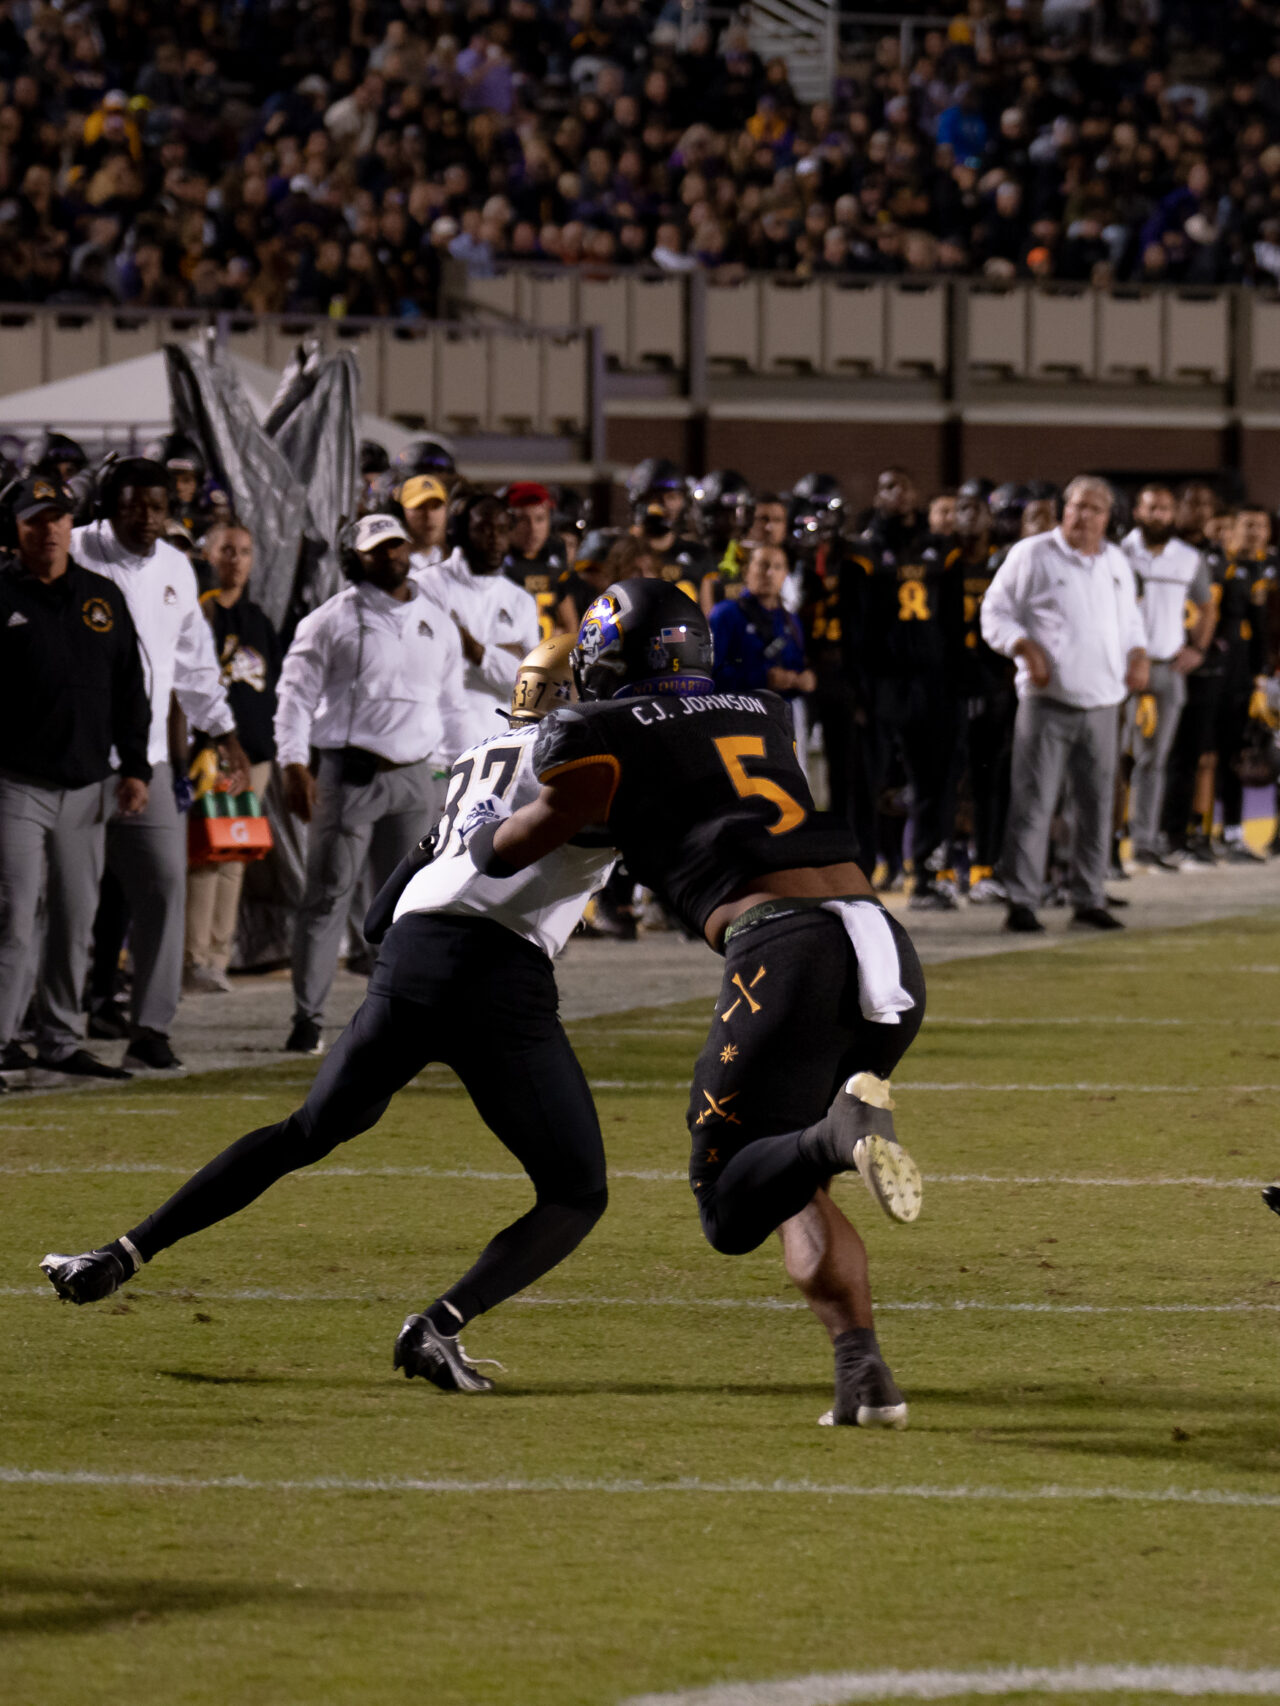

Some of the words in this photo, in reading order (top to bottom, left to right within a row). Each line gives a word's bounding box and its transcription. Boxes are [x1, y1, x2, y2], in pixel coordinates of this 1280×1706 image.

[672, 657, 680, 672] 5
[679, 694, 768, 716] JOHNSON
[713, 735, 806, 835] 5
[230, 820, 250, 844] G
